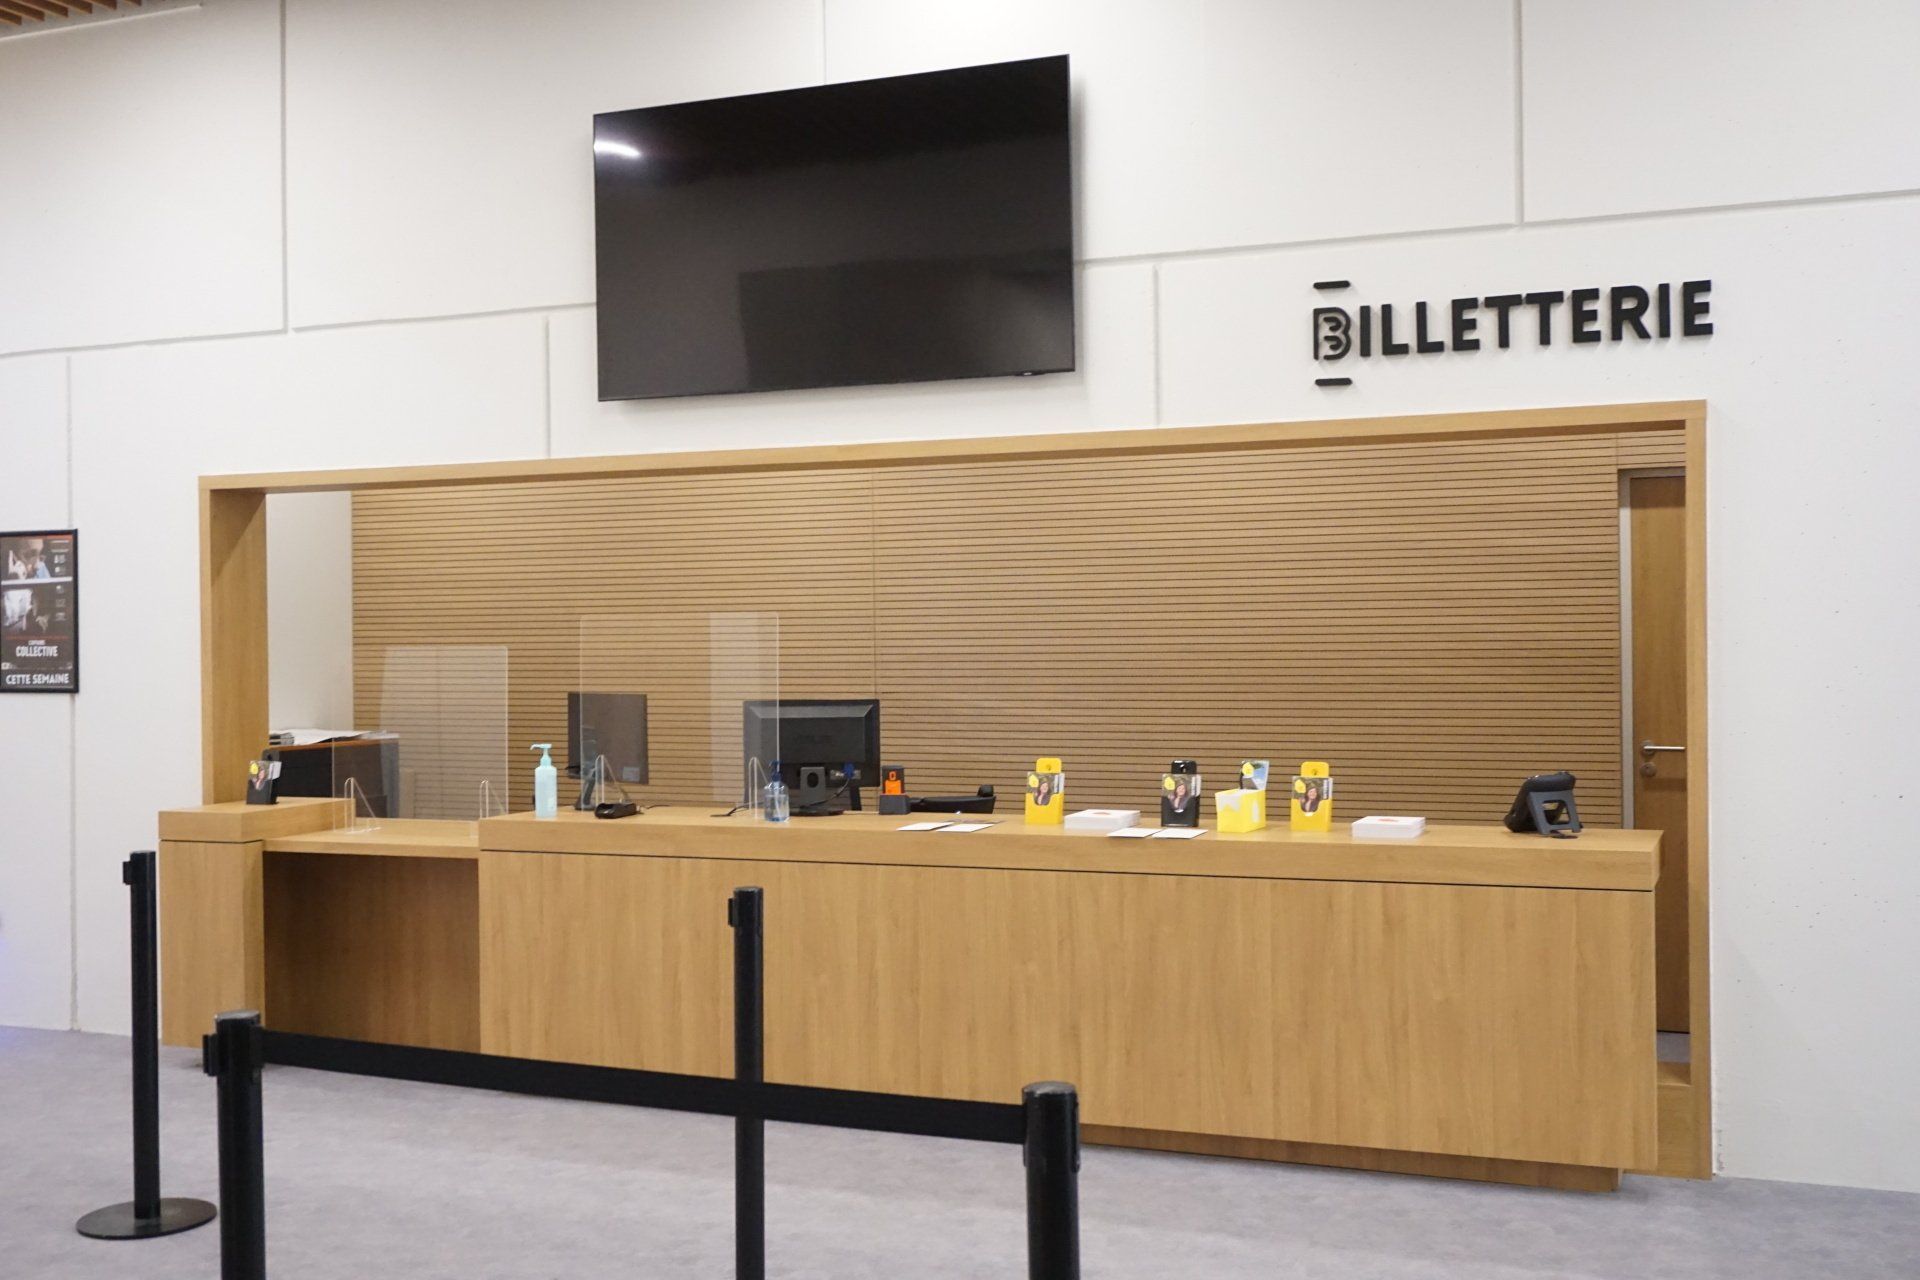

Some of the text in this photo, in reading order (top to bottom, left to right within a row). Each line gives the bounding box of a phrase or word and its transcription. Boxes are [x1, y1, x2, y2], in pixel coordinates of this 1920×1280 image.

[1313, 279, 1713, 361] BILLETTERIE
[16, 645, 59, 657] COLLECTIVE
[5, 673, 70, 685] CETTE SEMAINE
